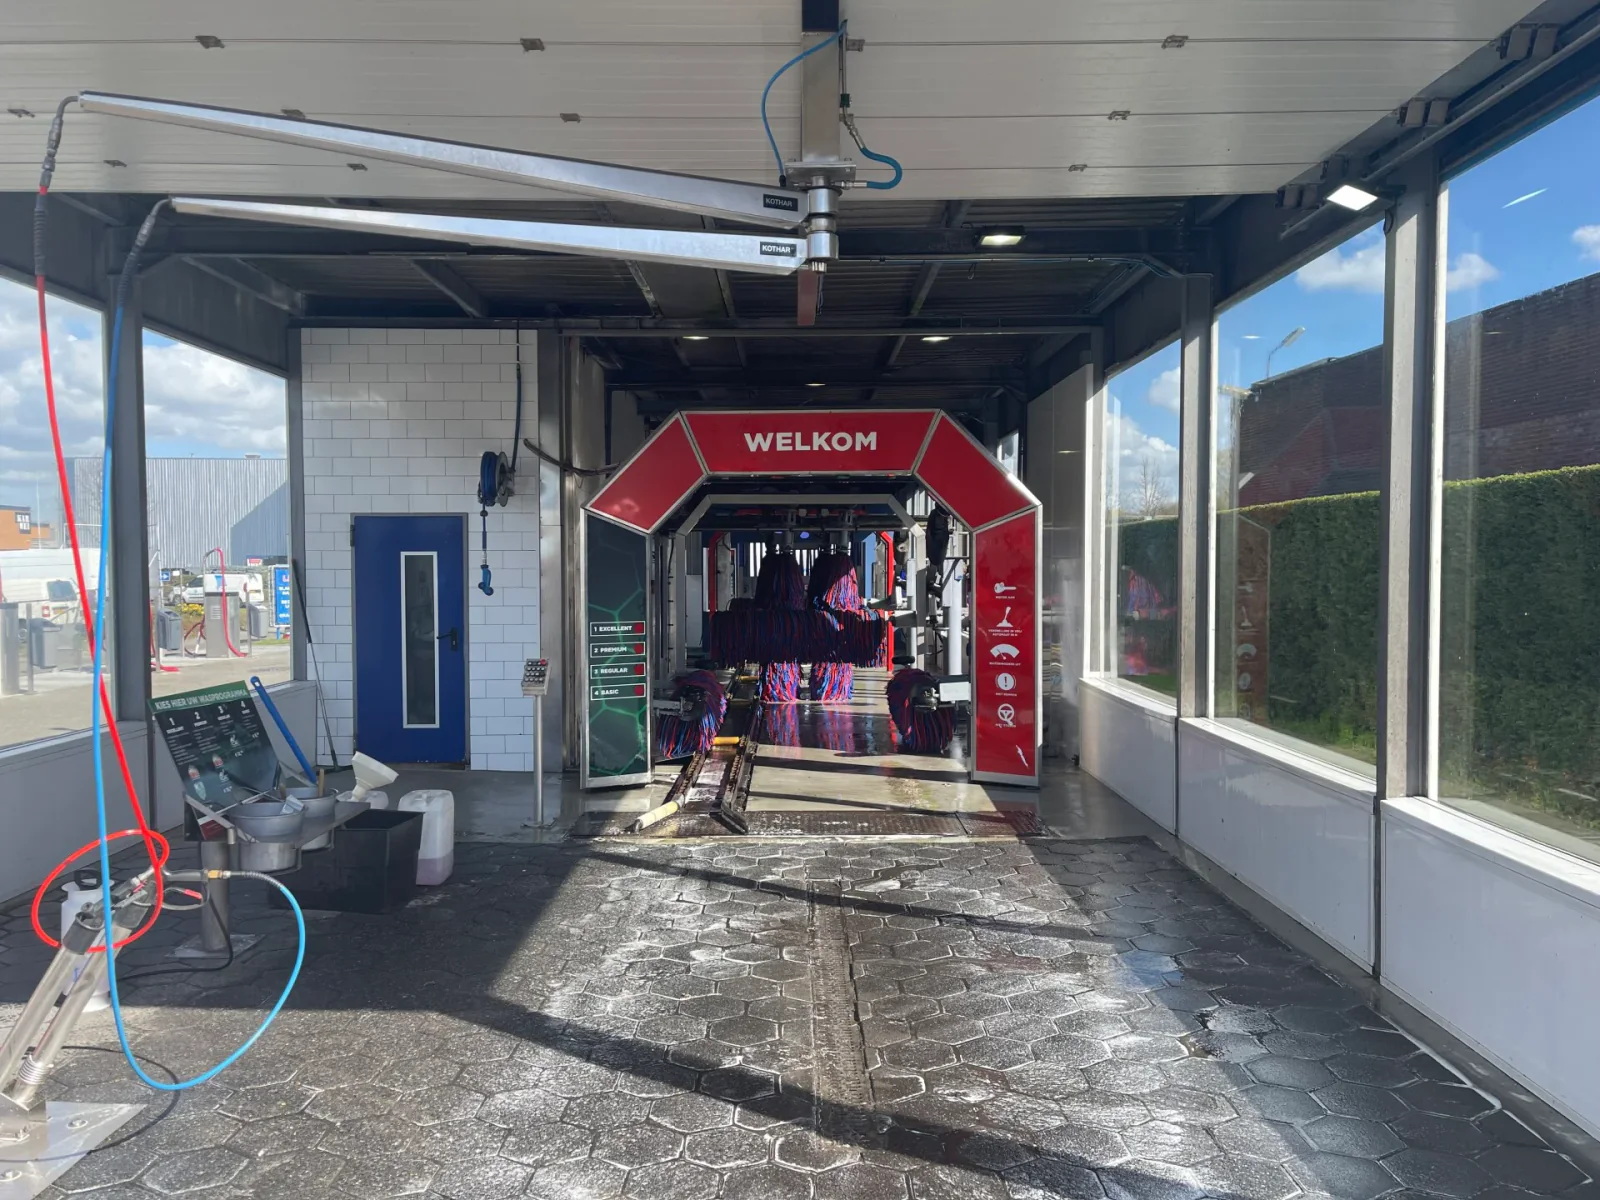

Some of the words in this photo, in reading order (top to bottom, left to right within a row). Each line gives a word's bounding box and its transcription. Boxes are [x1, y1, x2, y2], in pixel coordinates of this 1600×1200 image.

[765, 198, 792, 207] KOTHAR
[762, 244, 791, 253] KOTHAR
[744, 431, 877, 452] WELKOM
[155, 699, 171, 710] KIES
[170, 698, 187, 708] HIER
[187, 696, 198, 705] UW
[198, 689, 248, 704] WASPROGRAMMA
[194, 711, 200, 720] 2
[169, 717, 175, 726] 1
